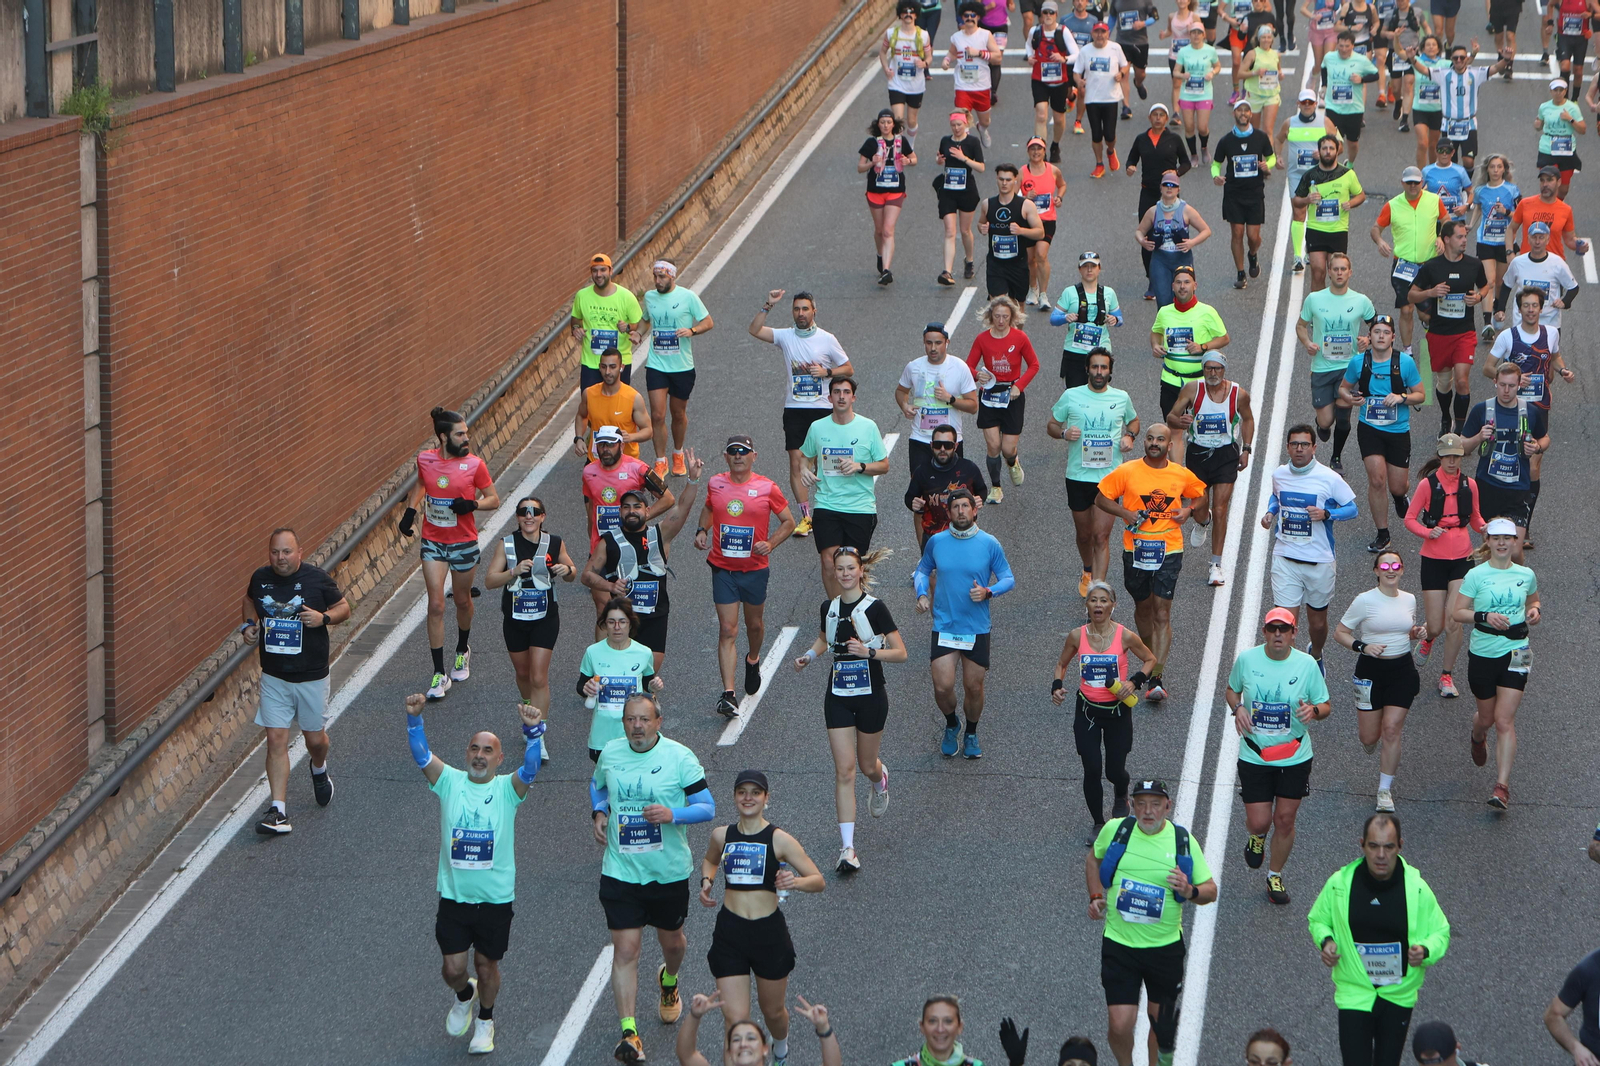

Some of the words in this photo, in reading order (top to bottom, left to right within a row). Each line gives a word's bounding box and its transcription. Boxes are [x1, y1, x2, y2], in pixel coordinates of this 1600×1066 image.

[1455, 86, 1465, 97] 10
[1532, 212, 1555, 220] CURSA
[1262, 715, 1280, 723] 11320
[465, 832, 490, 840] ZURICH
[629, 838, 651, 846] CLAUDIO
[736, 845, 761, 853] ZURICH
[1135, 885, 1160, 897] ZURICH
[1131, 897, 1148, 908] 12061
[1368, 946, 1395, 954] ZURICH
[1367, 960, 1386, 968] 11052
[1374, 968, 1395, 976] GARCÍA
